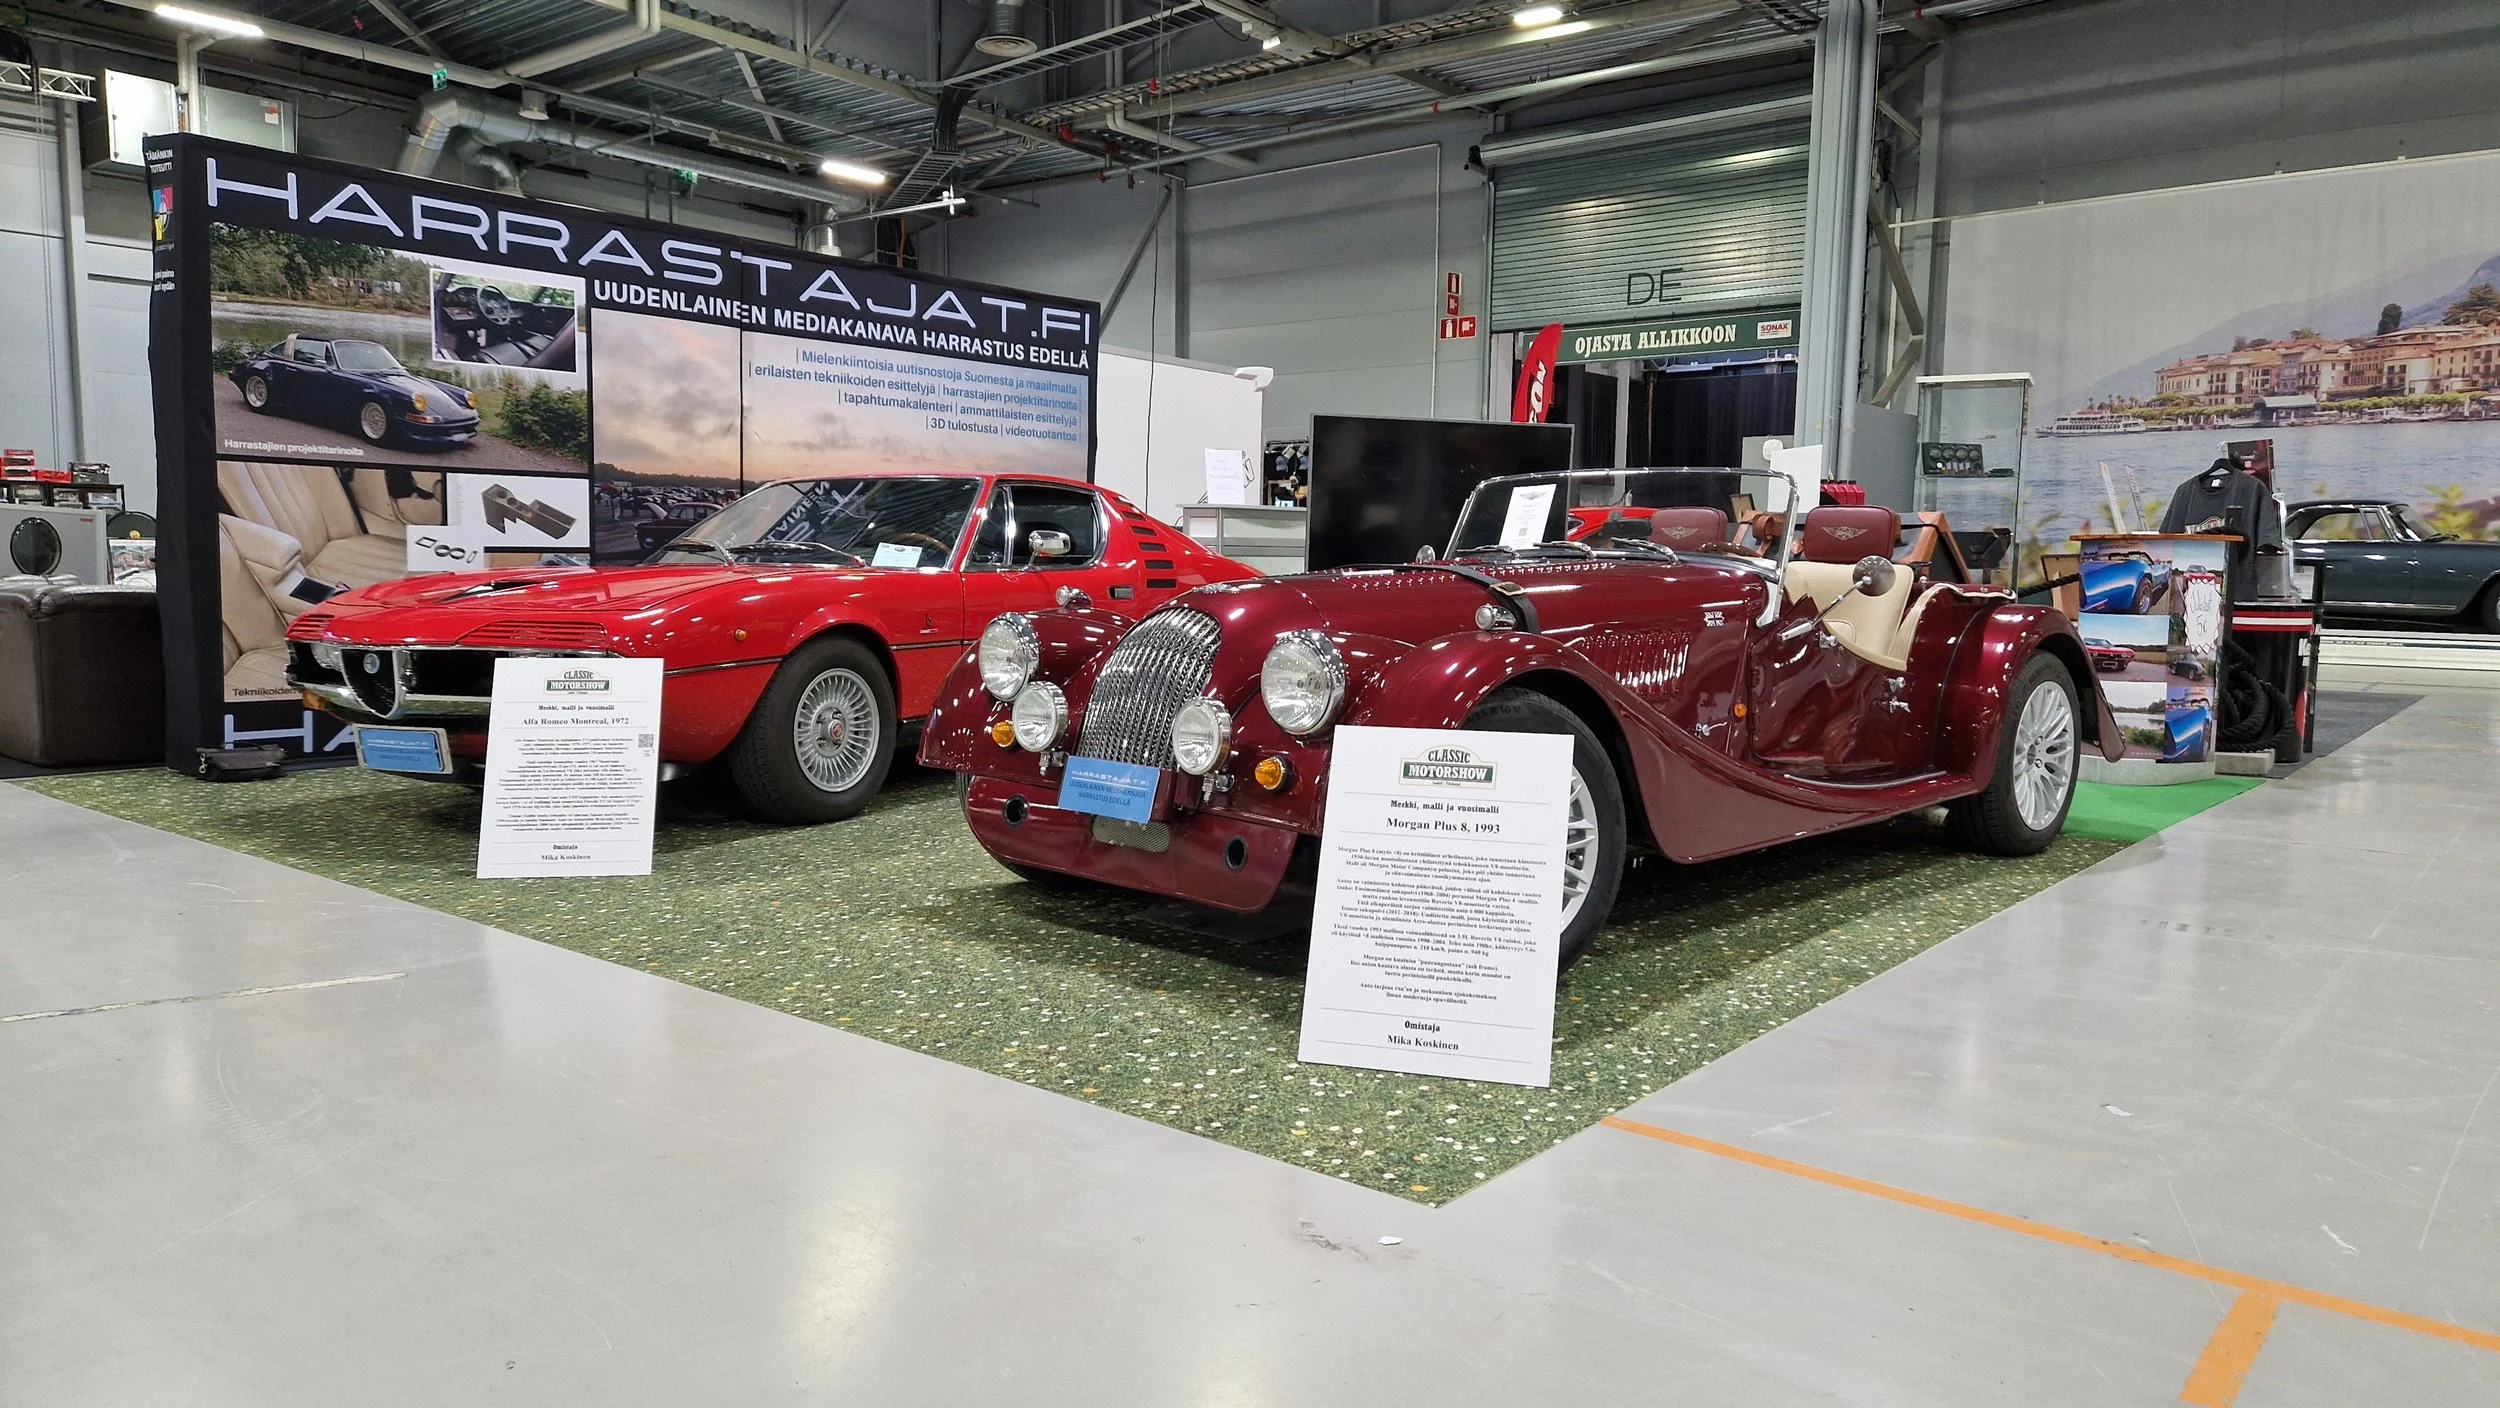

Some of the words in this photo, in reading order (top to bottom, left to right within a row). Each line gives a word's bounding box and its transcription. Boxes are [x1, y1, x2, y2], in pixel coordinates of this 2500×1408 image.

[207, 157, 1091, 345] HARRASTAJAT.FI
[1627, 268, 1684, 306] DE
[593, 279, 766, 325] UUDENLAINEN
[774, 308, 917, 346] MEDIAKANAVA
[923, 330, 1025, 361] HARRASTUS
[1029, 347, 1089, 369] EDELLÄ
[1760, 323, 1788, 331] SONAX
[1575, 333, 1632, 358] OJASTA
[1637, 324, 1737, 350] ALLIKKOON
[802, 350, 894, 373] Mielenkiintoisia
[896, 362, 962, 382] uutisnostoja
[964, 369, 1014, 388] Suomesta
[1015, 378, 1024, 390] ja
[1026, 379, 1077, 395] maailmalta
[754, 365, 812, 380] erilaisten
[814, 372, 886, 389] tekniikoiden
[887, 379, 936, 395] esittelyjä
[942, 385, 1002, 404] harrastajien
[1004, 392, 1077, 410] projektitarinoita
[844, 393, 953, 414] tapahtumakalenteri
[960, 405, 1034, 421] ammattilaisten
[1035, 412, 1077, 427] esittelyjä
[931, 418, 945, 429] 3D
[947, 420, 998, 435] tulostusta
[1005, 425, 1077, 442] videotuotantoa
[224, 439, 287, 453] Harrastajien
[288, 444, 364, 456] projektitarinoita
[563, 670, 594, 680] CLASSIC
[550, 681, 607, 690] MOTORSHOW
[570, 718, 609, 726] Montreal,
[611, 717, 629, 725] 1972
[1428, 749, 1470, 763] CLASSIC
[1408, 764, 1487, 780] MOTORSHOW
[1390, 800, 1419, 810] Merkki,
[1446, 803, 1454, 812] ja
[1457, 804, 1499, 813] vuosimalli
[1386, 817, 1430, 831] Morgan
[1434, 820, 1457, 832] Plus
[1460, 823, 1471, 834] 8,
[1475, 823, 1500, 834] 1993
[1404, 1020, 1441, 1032] Omistaja
[1387, 1035, 1412, 1047] Mika
[1415, 1037, 1459, 1051] Koskinen
